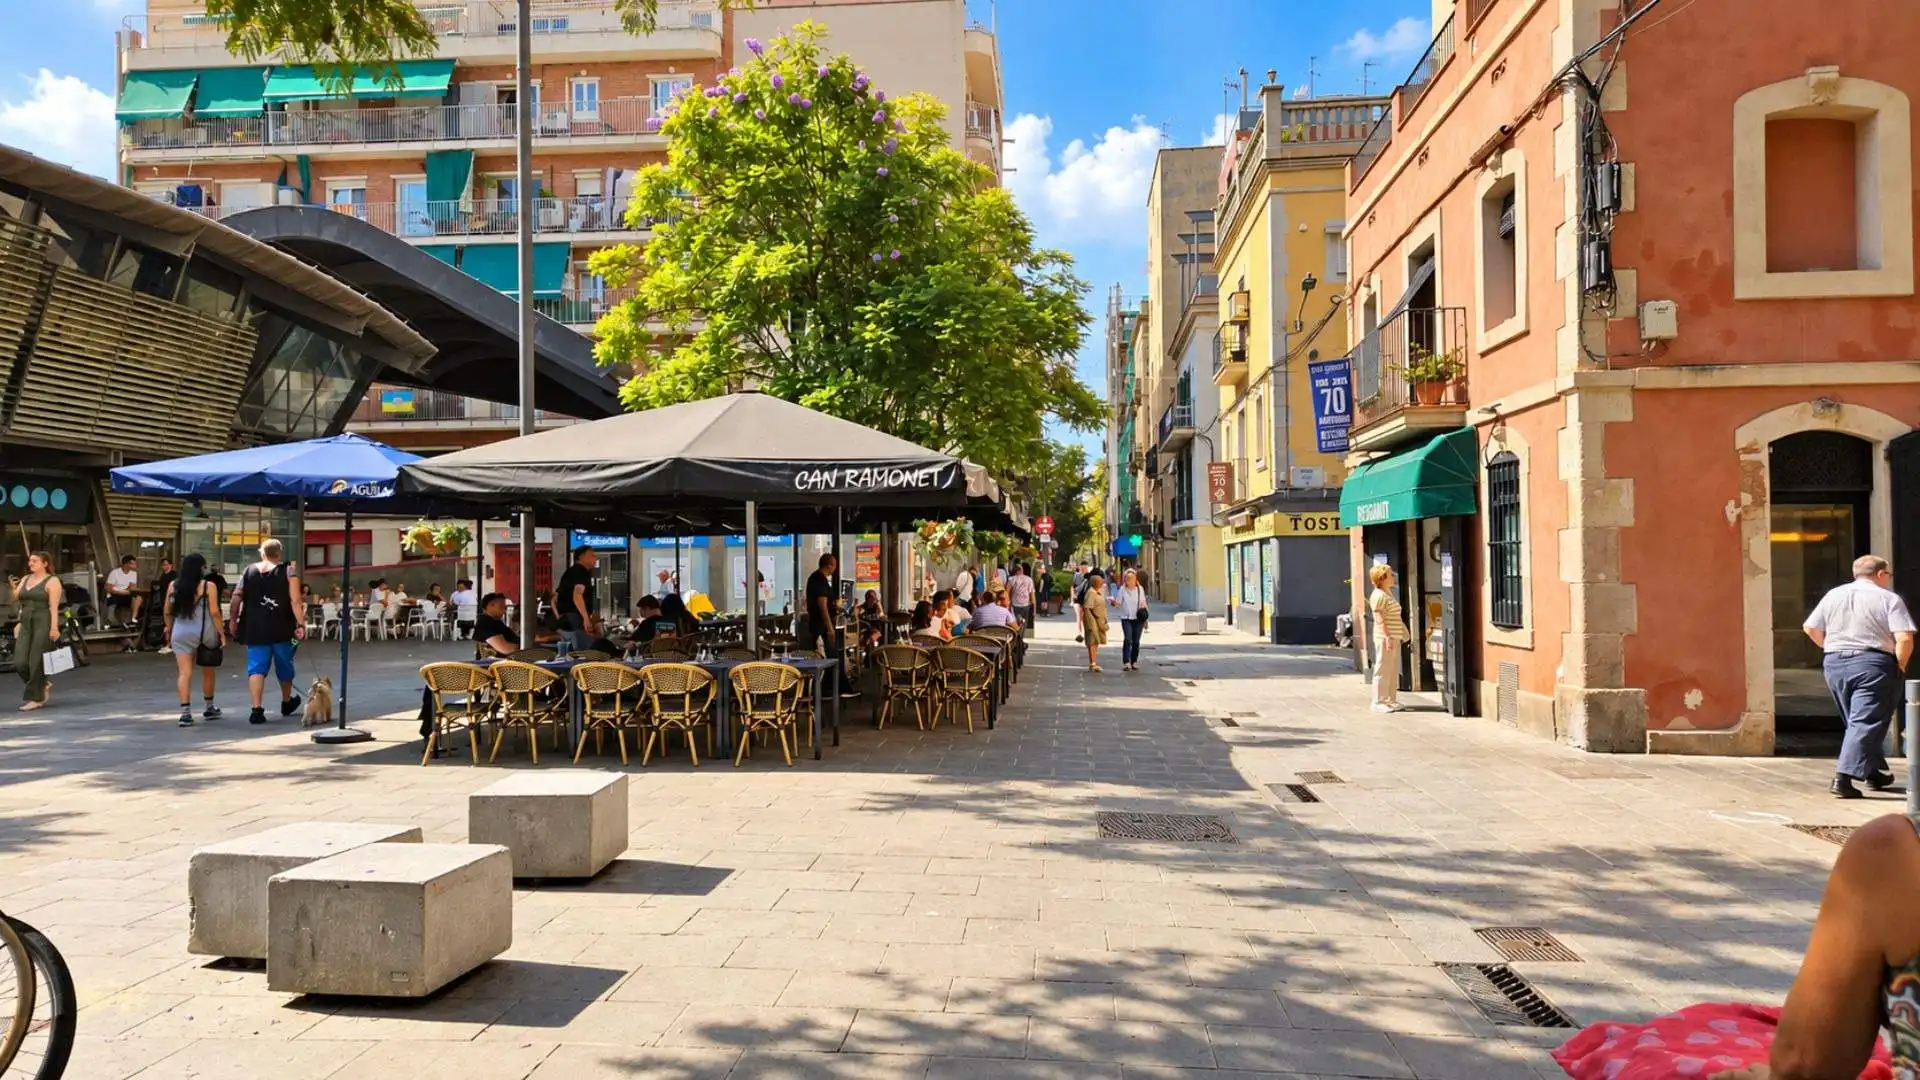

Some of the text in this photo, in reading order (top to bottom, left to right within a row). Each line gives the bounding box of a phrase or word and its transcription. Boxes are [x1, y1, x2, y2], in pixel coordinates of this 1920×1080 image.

[1320, 387, 1346, 415] 70
[795, 467, 944, 490] CAN RAMONET
